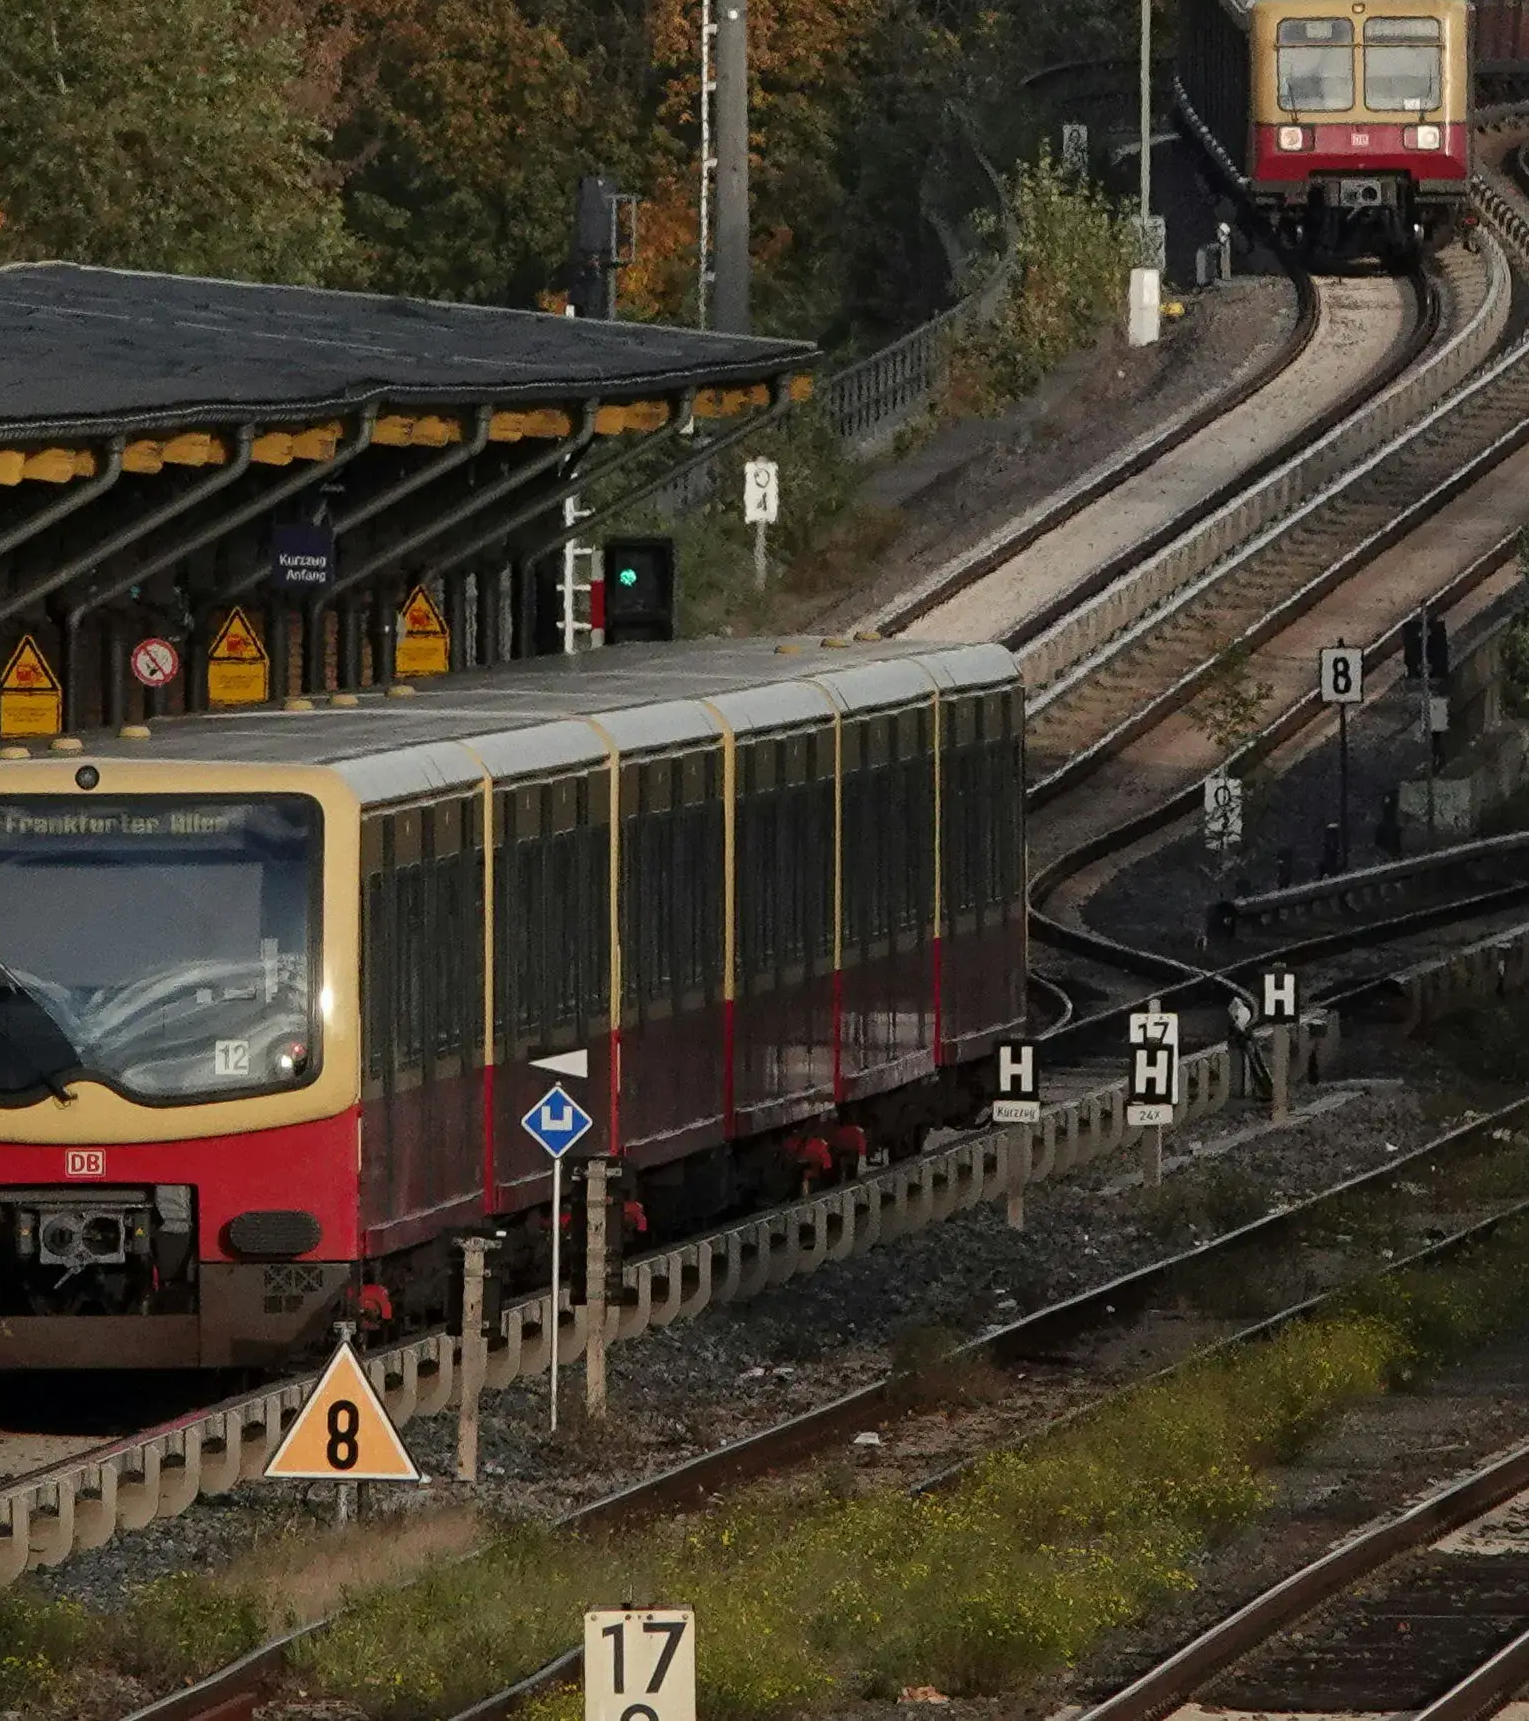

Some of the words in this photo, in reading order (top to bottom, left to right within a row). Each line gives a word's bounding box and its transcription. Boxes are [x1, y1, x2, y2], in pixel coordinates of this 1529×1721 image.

[279, 554, 327, 569] Kurzzug
[286, 568, 327, 583] Anfang
[1332, 656, 1351, 695] 8
[6, 815, 160, 836] Frankfurter
[1264, 973, 1296, 1017] H
[1138, 1022, 1169, 1044] 17
[218, 1045, 249, 1071] 12
[999, 1045, 1033, 1093] H
[1135, 1049, 1169, 1095] H
[70, 1154, 102, 1172] DB
[326, 1399, 360, 1471] 8
[601, 1621, 687, 1695] 17
